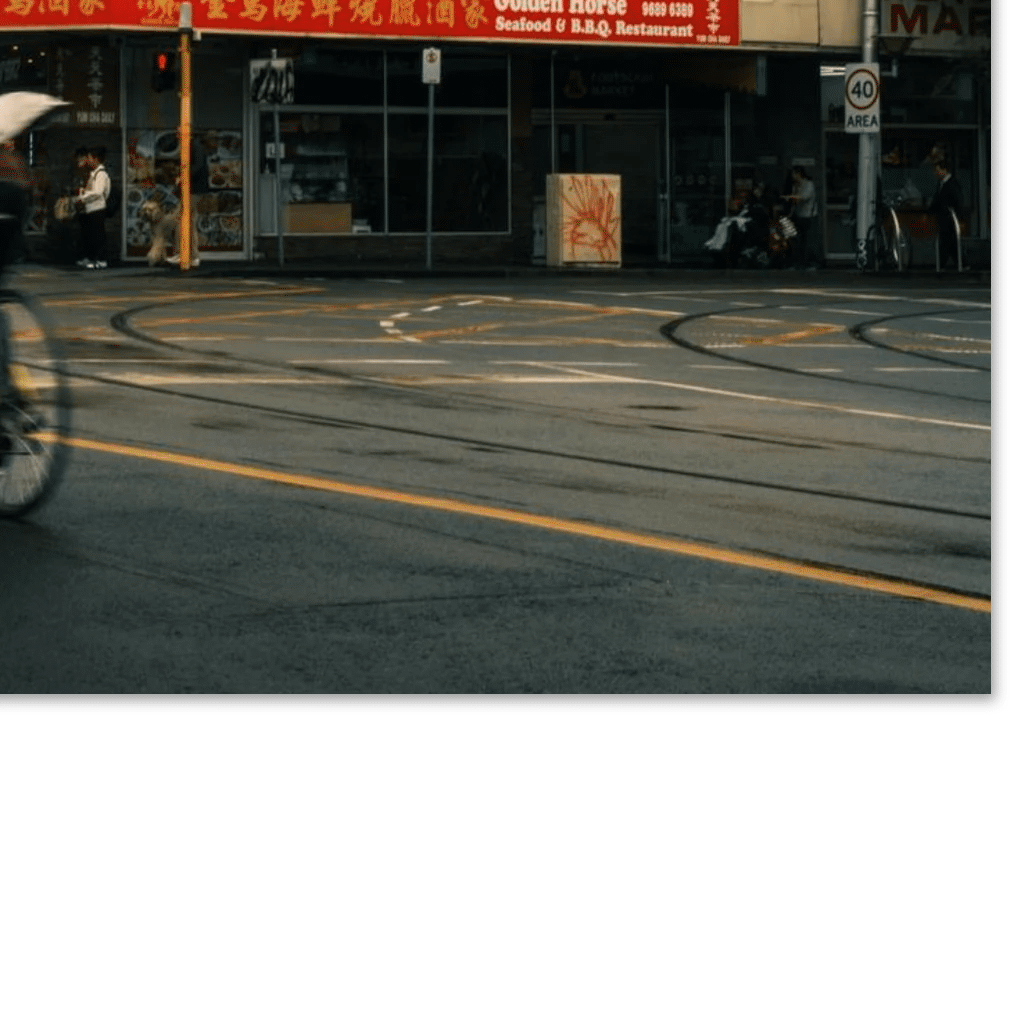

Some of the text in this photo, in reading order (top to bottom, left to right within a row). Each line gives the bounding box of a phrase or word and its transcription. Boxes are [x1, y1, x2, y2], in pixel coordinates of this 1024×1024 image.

[494, 15, 695, 39] Seafood & B.B.Q. Restaurant
[850, 80, 874, 99] 40
[847, 114, 878, 127] AREA
